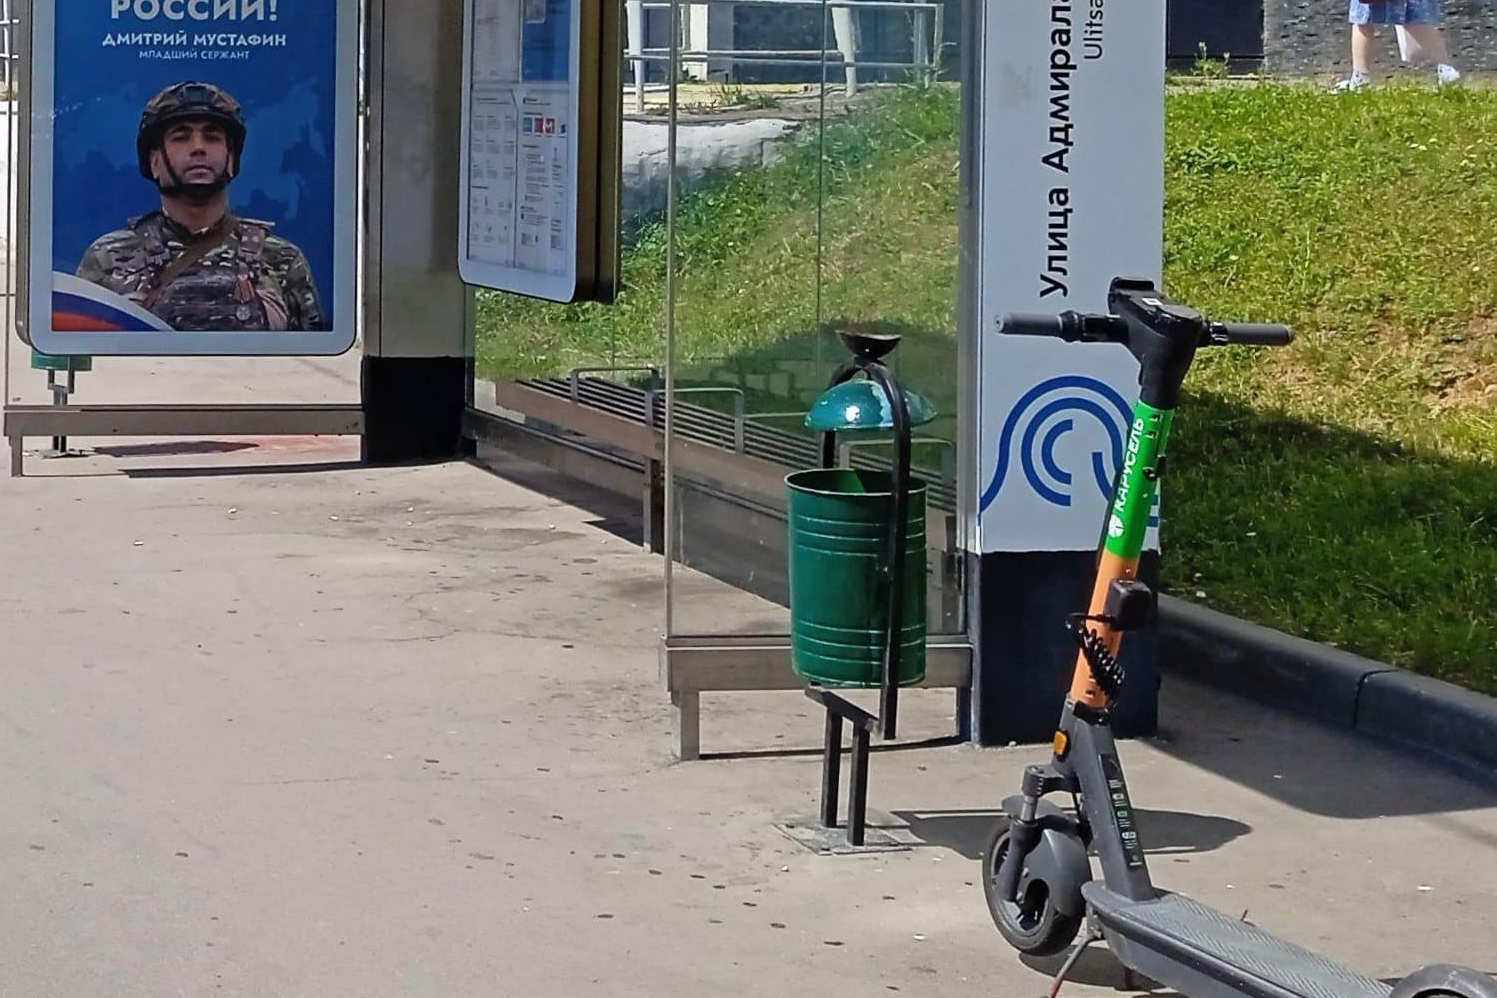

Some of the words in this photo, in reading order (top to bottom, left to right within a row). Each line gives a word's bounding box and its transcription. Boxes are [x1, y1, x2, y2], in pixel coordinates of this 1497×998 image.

[102, 29, 188, 47] ДМИТРИЙ
[193, 33, 287, 47] МУСТАФИН
[138, 49, 198, 60] МЛАДШИЙ
[200, 50, 251, 60] СЕРЖАНТ
[1039, 187, 1074, 298] Улица
[1113, 418, 1145, 513] КАРУСЕЛЬ
